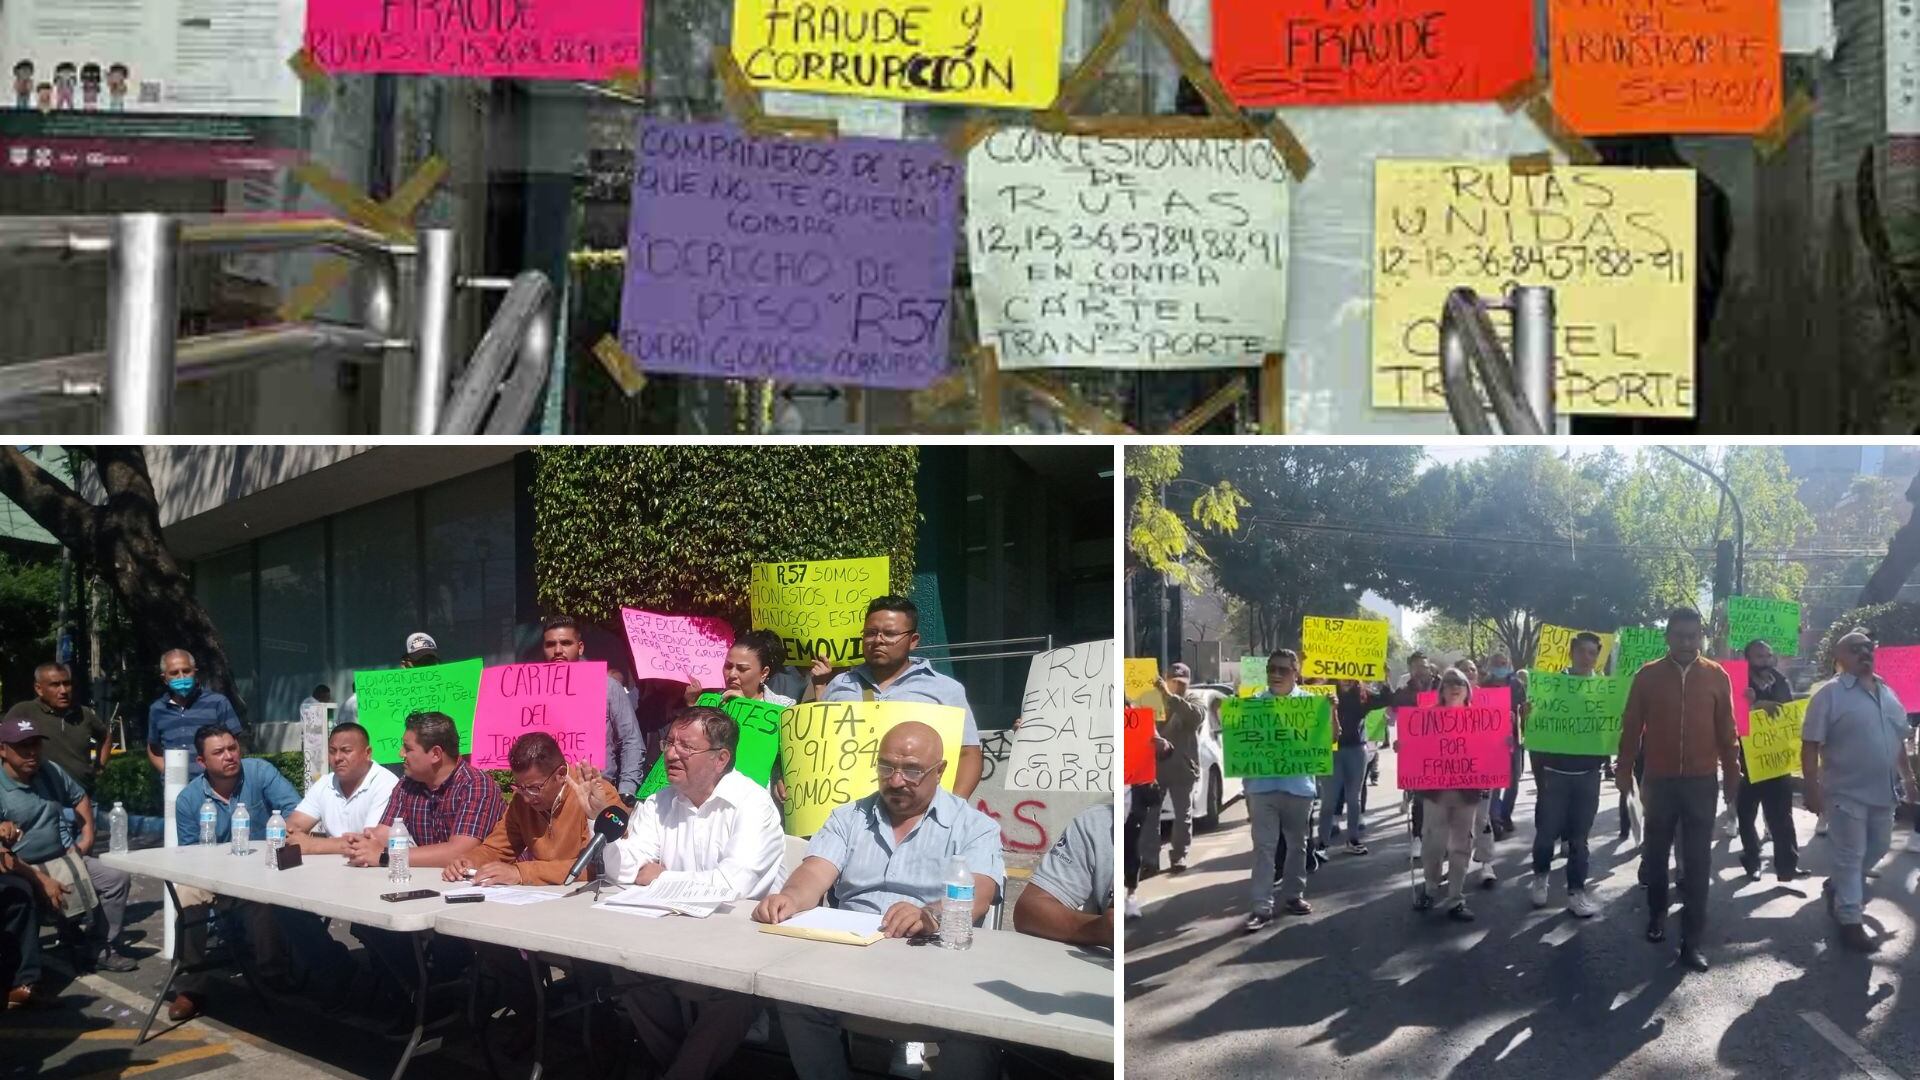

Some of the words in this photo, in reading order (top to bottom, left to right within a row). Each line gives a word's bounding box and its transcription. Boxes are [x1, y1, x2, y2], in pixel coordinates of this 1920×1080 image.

[765, 0, 932, 47] FRAUDE
[1286, 12, 1446, 67] FRAUDE
[1561, 32, 1772, 68] TRANSPORTE
[637, 165, 698, 197] QUE
[711, 177, 753, 205] NO
[769, 182, 813, 207] TE
[1090, 168, 1138, 187] DE
[1443, 165, 1615, 210] RUTAS
[997, 184, 1251, 227] RUTAS
[1391, 204, 1673, 262] UNIDAS
[855, 257, 900, 293] DE
[1026, 263, 1074, 283] EN
[1093, 261, 1221, 286] CONTRA
[851, 293, 948, 347] R57
[986, 329, 1266, 362] TRANSPORTE
[1402, 317, 1642, 360] CEL
[752, 565, 769, 583] EN
[776, 564, 807, 586] R57
[811, 566, 870, 583] SOMOS
[835, 587, 873, 605] LOS
[752, 607, 820, 629] MAÑOSOS
[829, 604, 868, 629] ESTÁ
[1324, 619, 1345, 632] R57
[791, 628, 810, 637] EN
[1541, 624, 1572, 647] RUT
[667, 645, 690, 657] DEL
[780, 637, 865, 661] EMOVI
[650, 656, 713, 676] GORDOS
[1042, 642, 1114, 682] RU
[1312, 660, 1377, 678] SEMOVI
[356, 680, 465, 698] TRANSPORTISTAS
[358, 698, 380, 711] NO
[386, 697, 403, 708] SE
[452, 689, 477, 702] DEL
[521, 704, 551, 728] DEL
[1584, 699, 1606, 714] DE
[1232, 728, 1309, 744] BIEN
[1438, 736, 1466, 757] POR
[1422, 757, 1479, 777] FRAUDE
